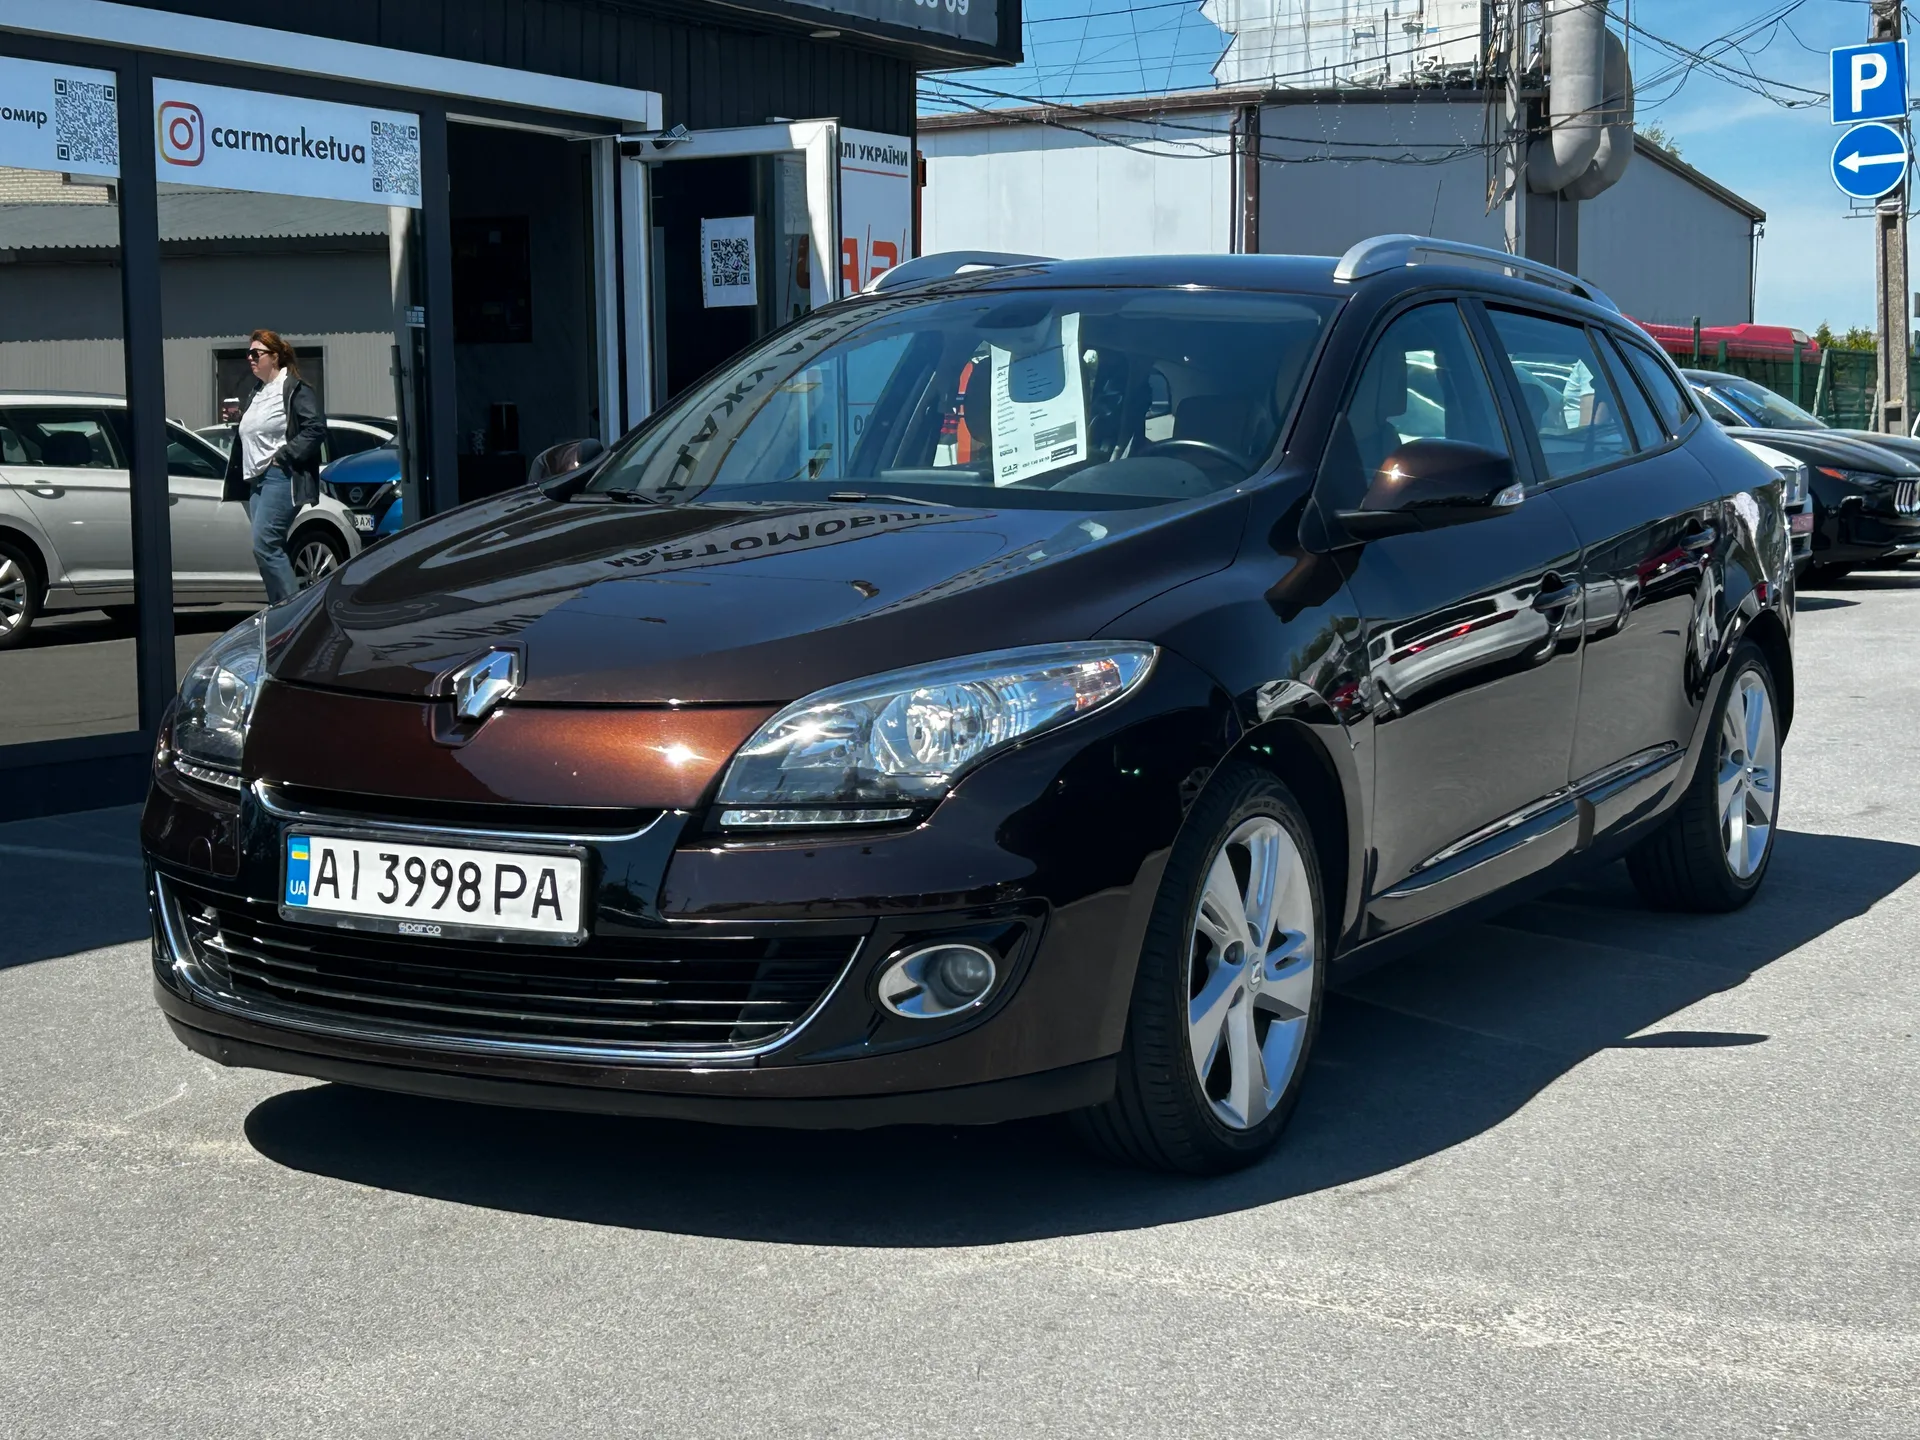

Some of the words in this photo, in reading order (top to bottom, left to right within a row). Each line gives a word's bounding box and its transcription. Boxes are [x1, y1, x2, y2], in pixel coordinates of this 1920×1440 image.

[1852, 53, 1887, 113] P
[0, 107, 48, 129] омир
[211, 126, 366, 164] carmarketua
[859, 144, 908, 166] УКРАЇНИ
[290, 879, 307, 896] UA
[313, 848, 360, 900] AI
[377, 853, 482, 912] 3998
[494, 863, 563, 921] PA
[398, 922, 441, 934] sparco
